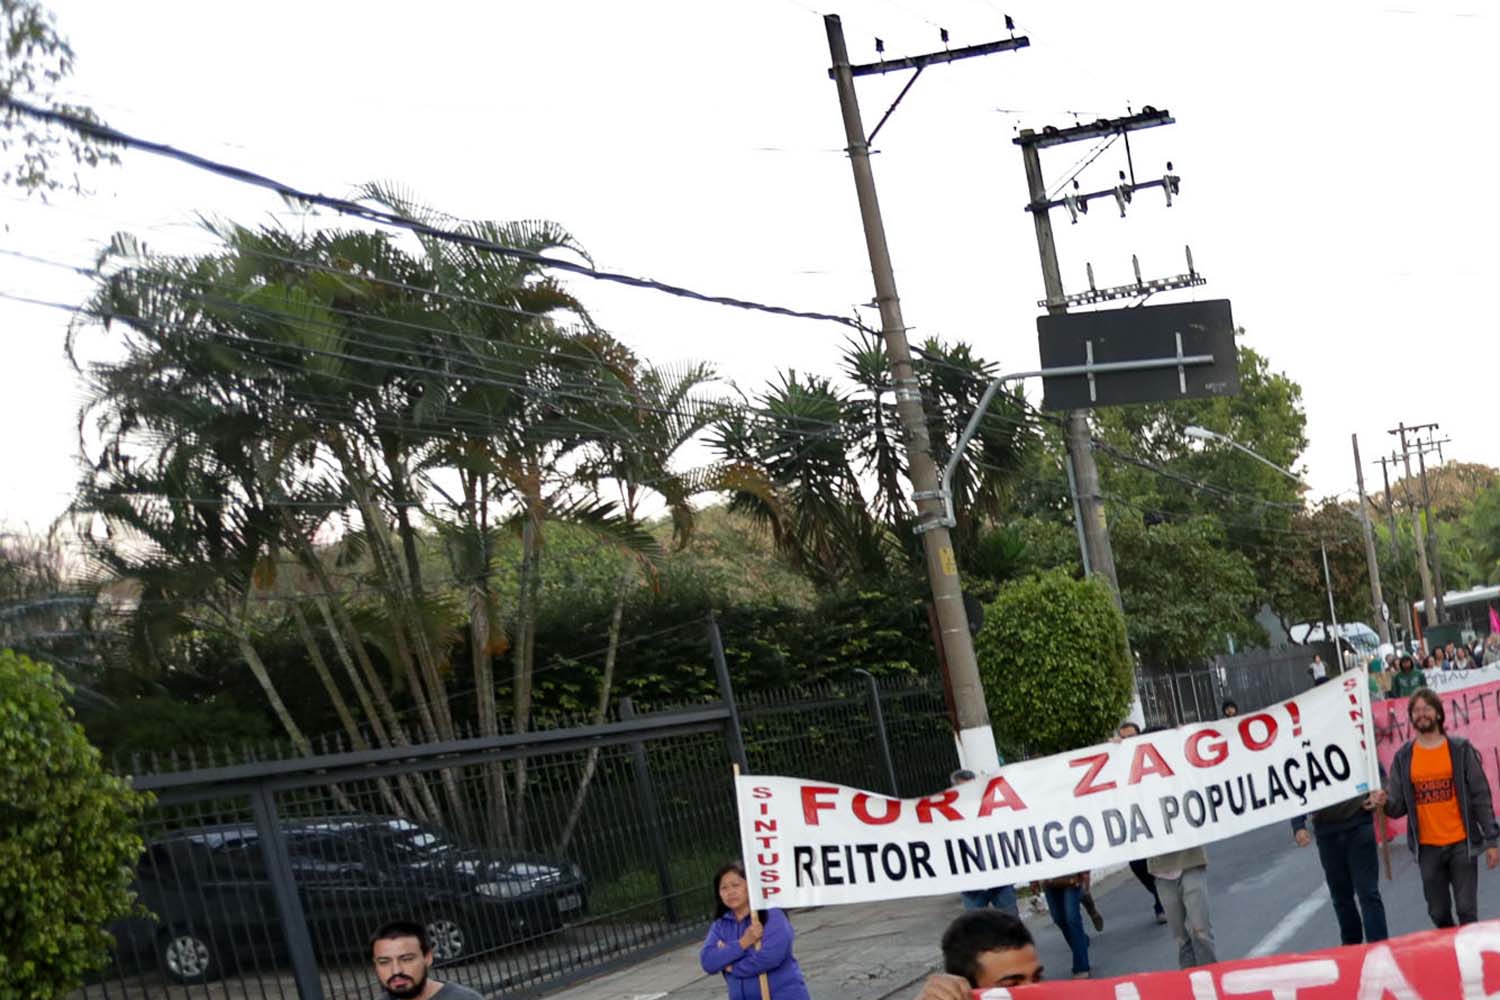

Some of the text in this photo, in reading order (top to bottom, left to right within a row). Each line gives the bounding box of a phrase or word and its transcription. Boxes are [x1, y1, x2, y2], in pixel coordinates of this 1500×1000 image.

[793, 740, 1350, 887] REITOR INIMIGO DA POPULAÇÃO
[800, 701, 1302, 825] FORA ZAGO!
[752, 786, 782, 899] SINTUSP
